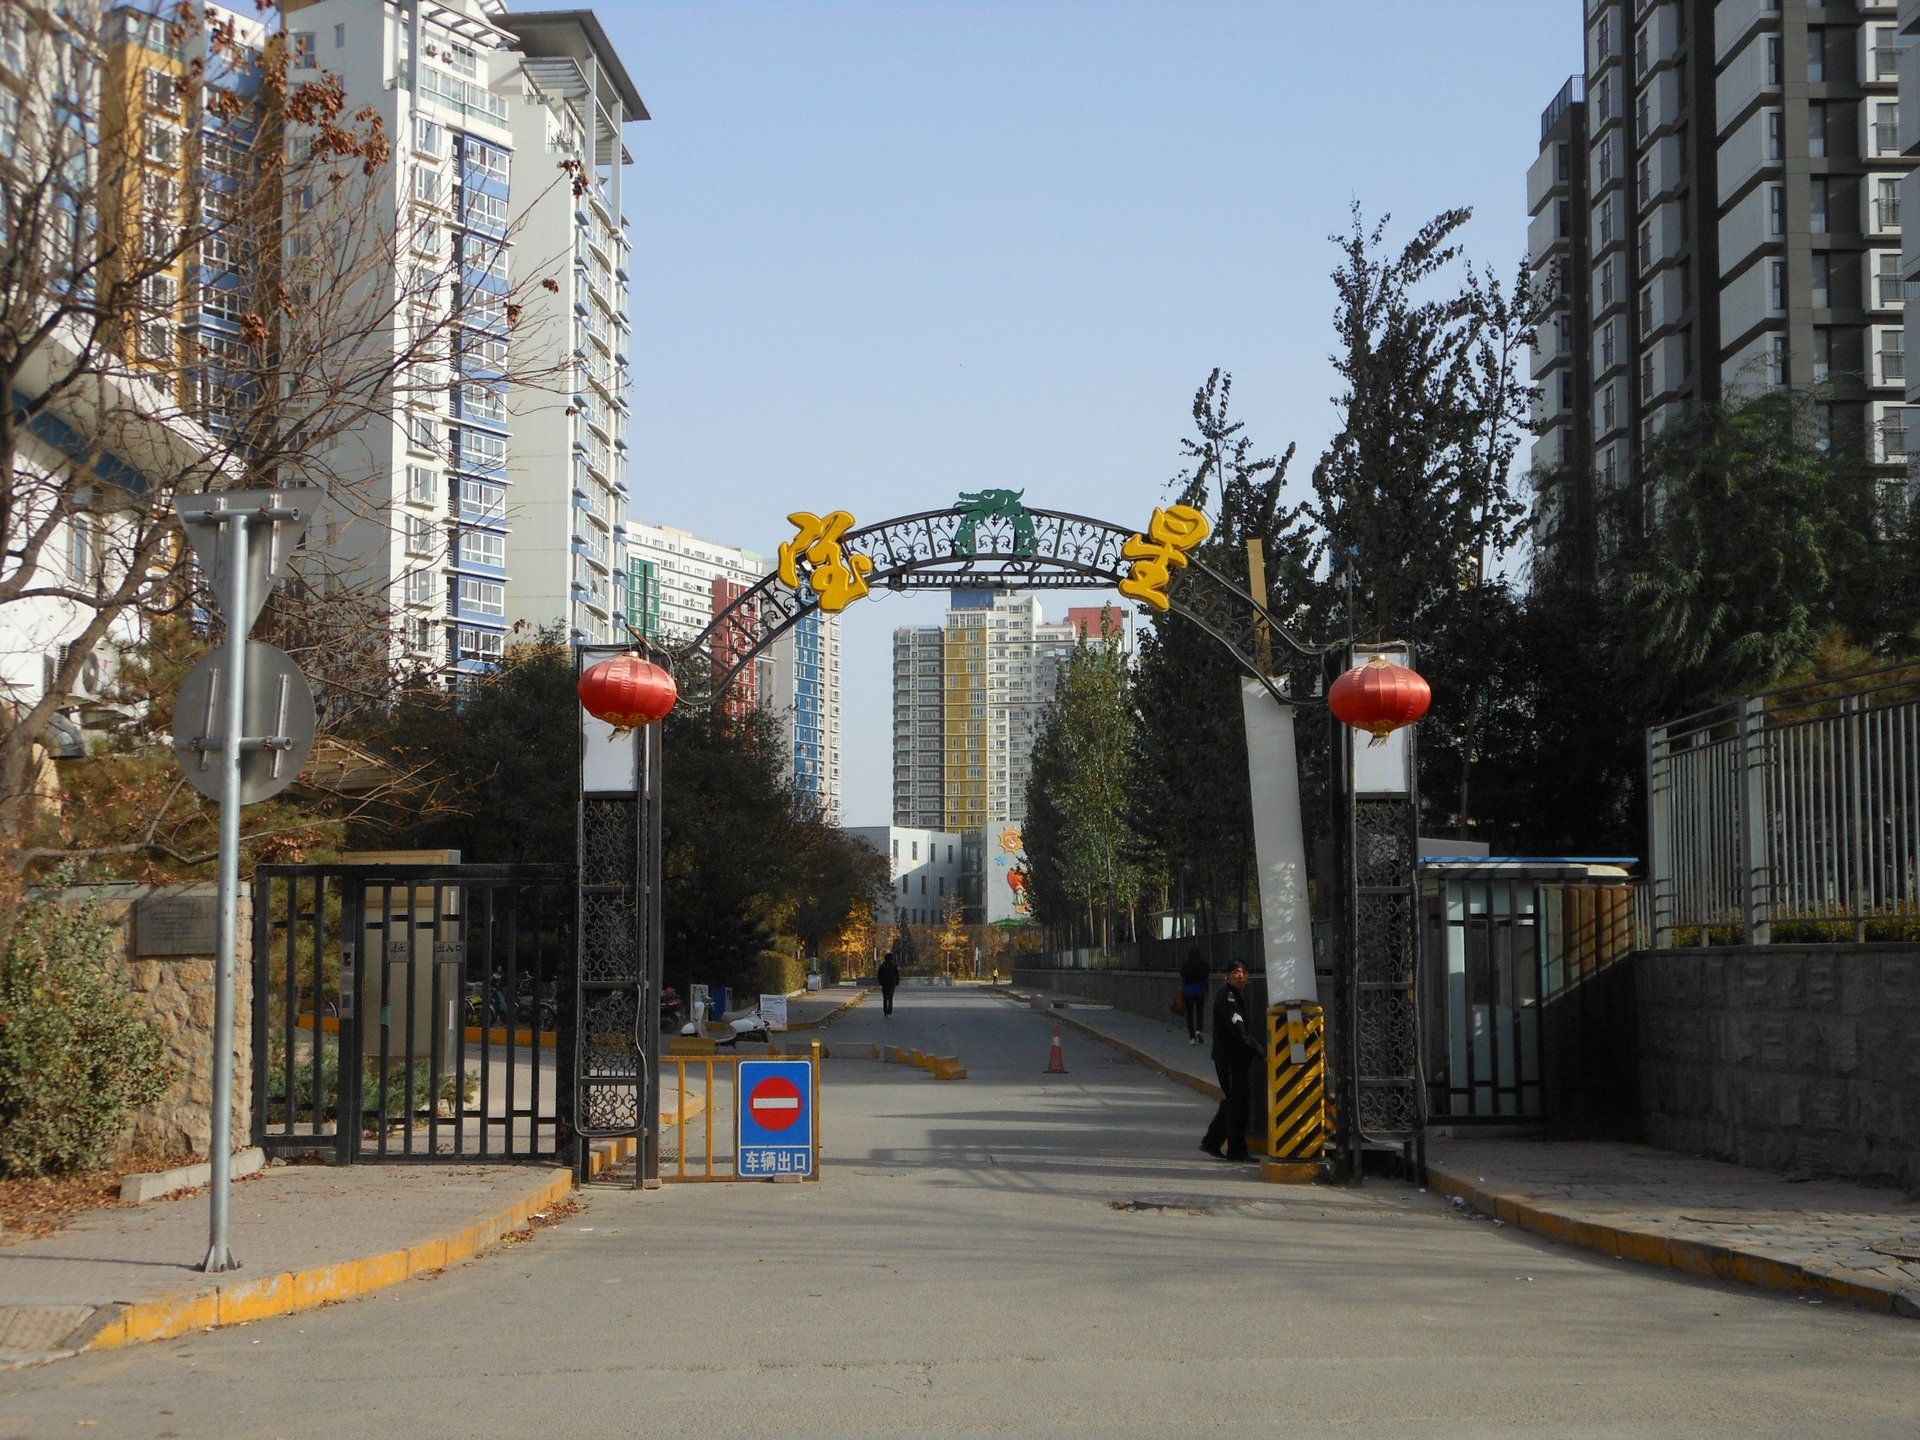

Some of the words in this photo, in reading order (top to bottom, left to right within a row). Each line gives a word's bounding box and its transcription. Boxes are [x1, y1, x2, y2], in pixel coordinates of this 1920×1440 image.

[437, 944, 462, 953] 出入口
[745, 1151, 806, 1172] 车辆出口
